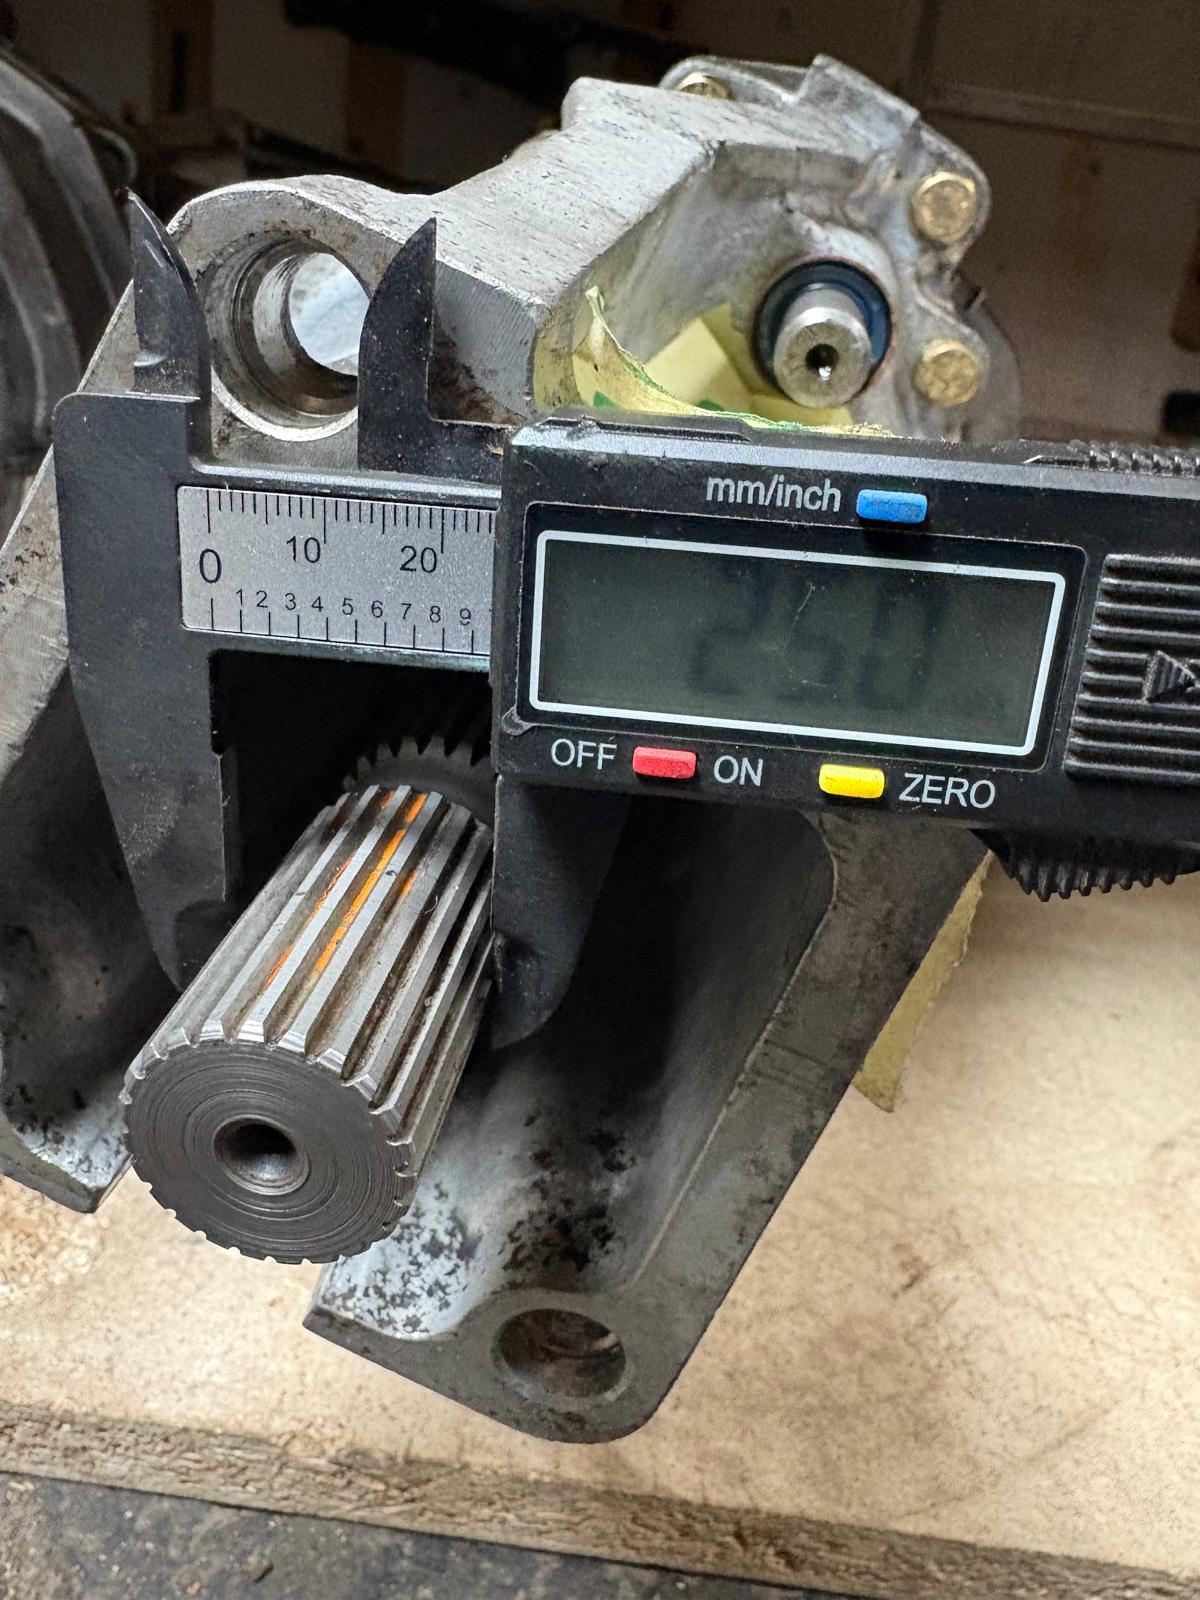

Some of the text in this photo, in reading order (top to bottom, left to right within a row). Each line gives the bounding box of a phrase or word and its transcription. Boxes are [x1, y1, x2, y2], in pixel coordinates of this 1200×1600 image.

[706, 473, 842, 512] mm/inch
[199, 536, 437, 584] 0 10 20
[236, 589, 471, 625] 1 2 3 4 5 6 7 8 9
[550, 738, 618, 770] OFF
[713, 755, 764, 786] ON
[898, 772, 996, 809] ZERO
